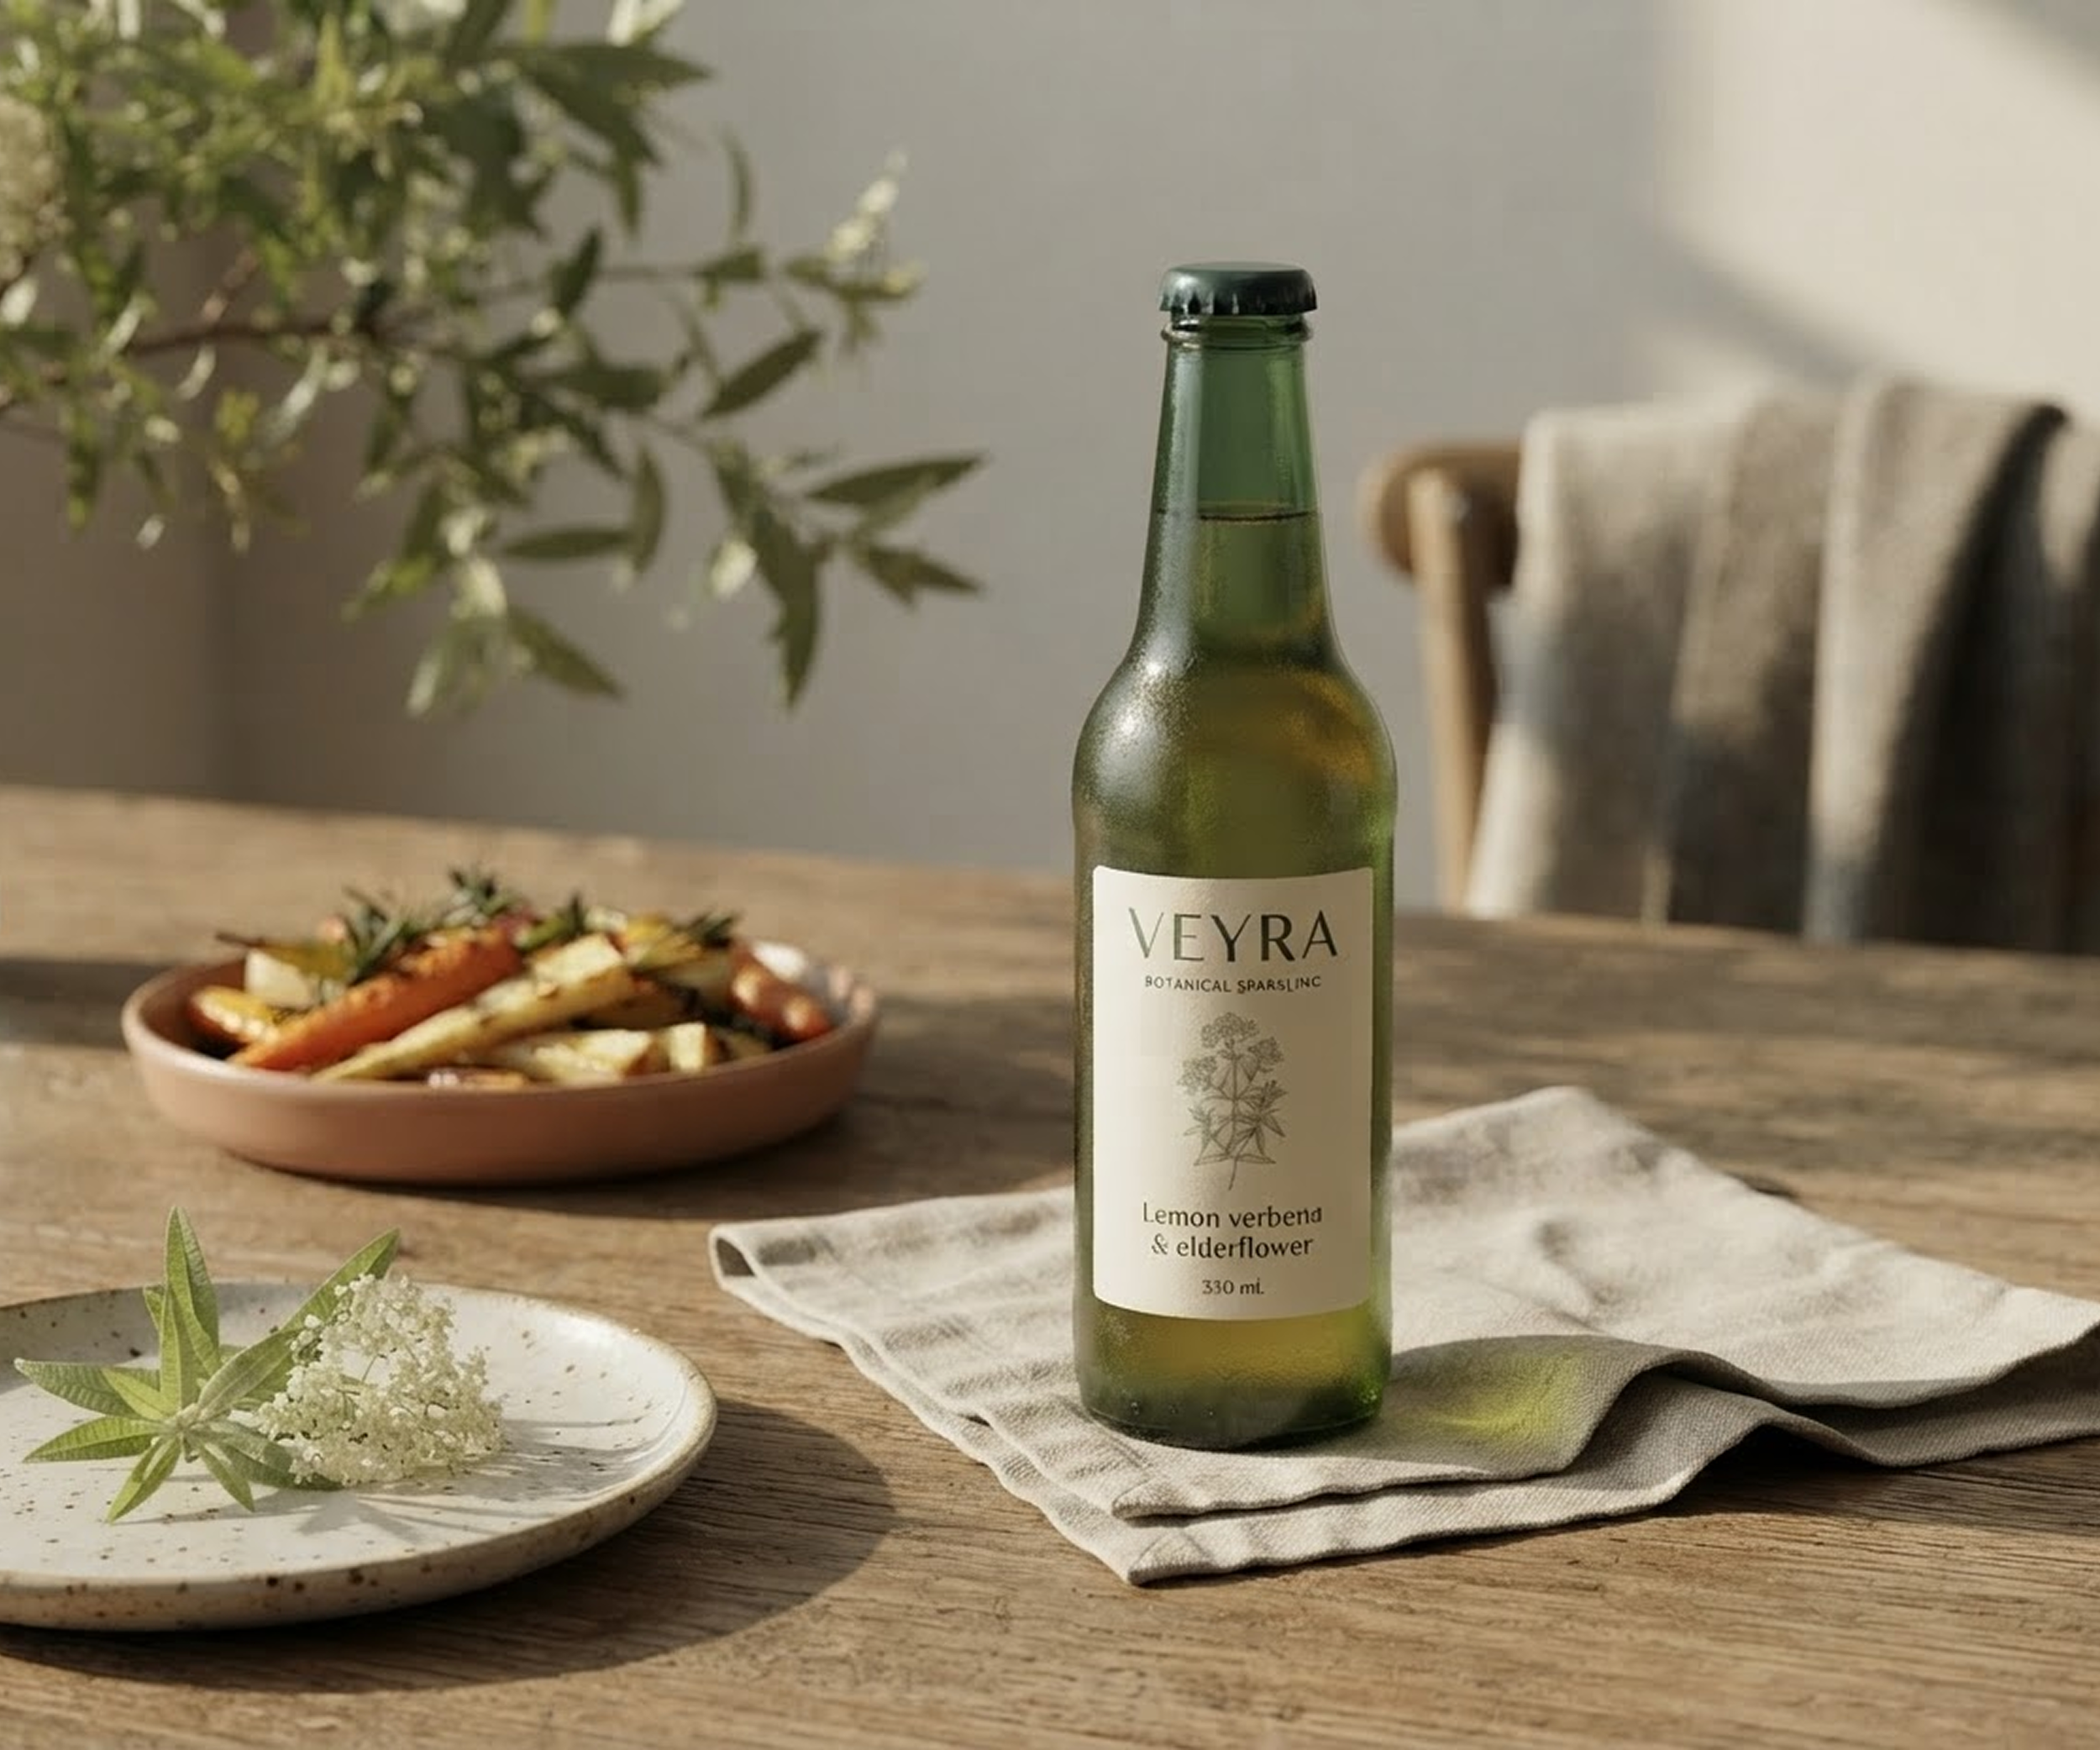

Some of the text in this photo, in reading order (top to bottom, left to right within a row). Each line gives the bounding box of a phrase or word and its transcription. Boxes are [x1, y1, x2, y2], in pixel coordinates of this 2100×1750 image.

[1127, 907, 1339, 963] VEYRA
[1144, 975, 1232, 993] BOTANICAL
[1142, 1201, 1221, 1228] Lemon
[1151, 1233, 1315, 1259] & elderflower
[1201, 1279, 1235, 1295] 330
